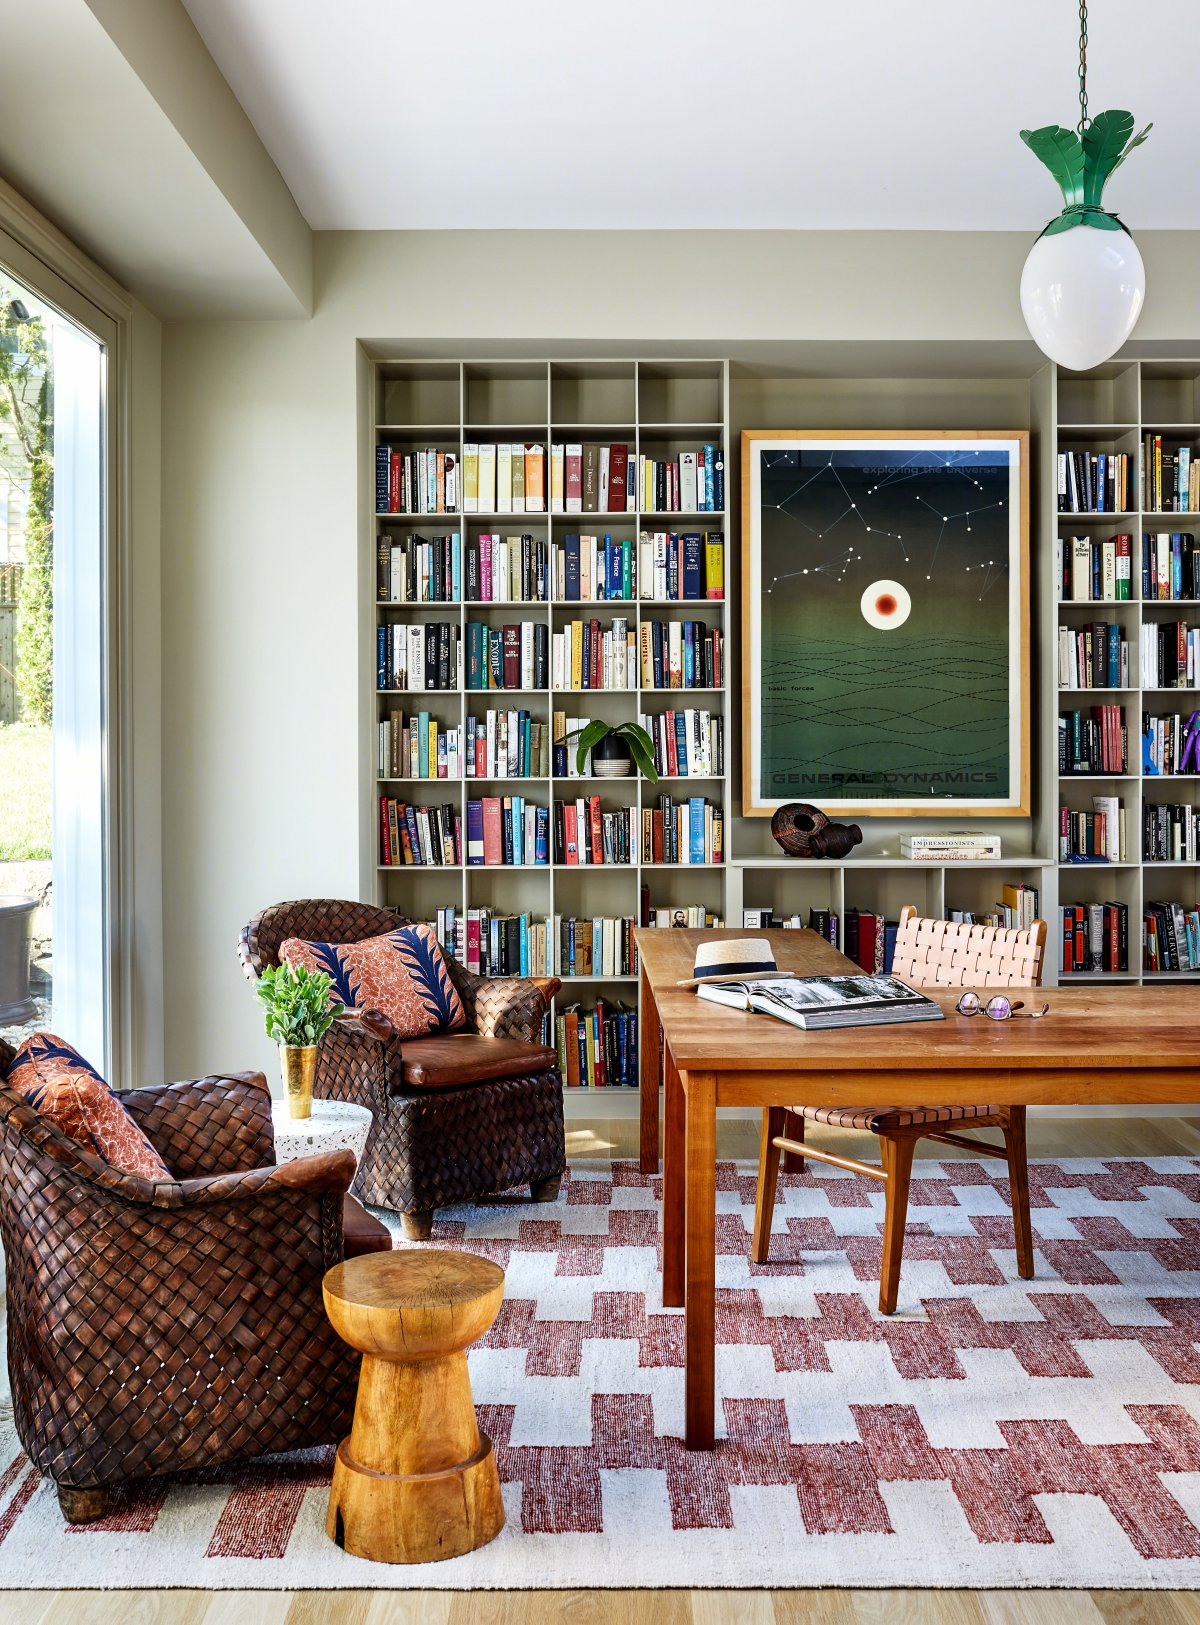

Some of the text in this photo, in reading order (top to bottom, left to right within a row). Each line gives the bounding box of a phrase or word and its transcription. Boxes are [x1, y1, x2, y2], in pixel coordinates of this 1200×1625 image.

[863, 465, 998, 476] exploring the universe
[490, 639, 500, 676] EXODUS
[772, 772, 999, 783] GENERAL DYNAMICS
[1167, 925, 1177, 958] SWERVE
